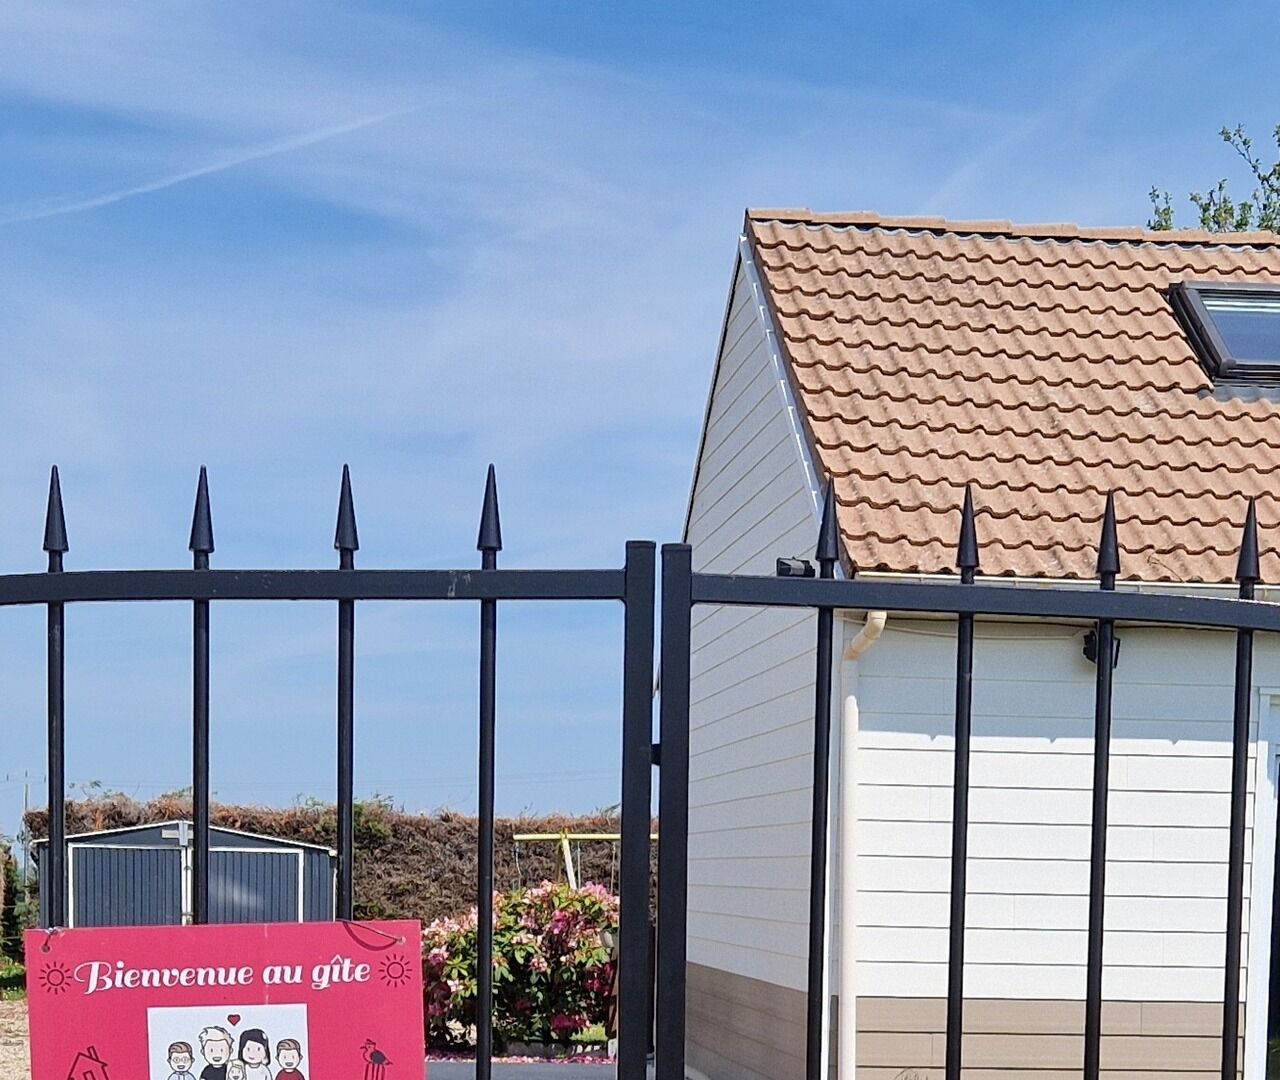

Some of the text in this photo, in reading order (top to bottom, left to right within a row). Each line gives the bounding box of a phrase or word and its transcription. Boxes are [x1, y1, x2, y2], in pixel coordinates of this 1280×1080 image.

[73, 954, 371, 996] Bienvenue au gîte
